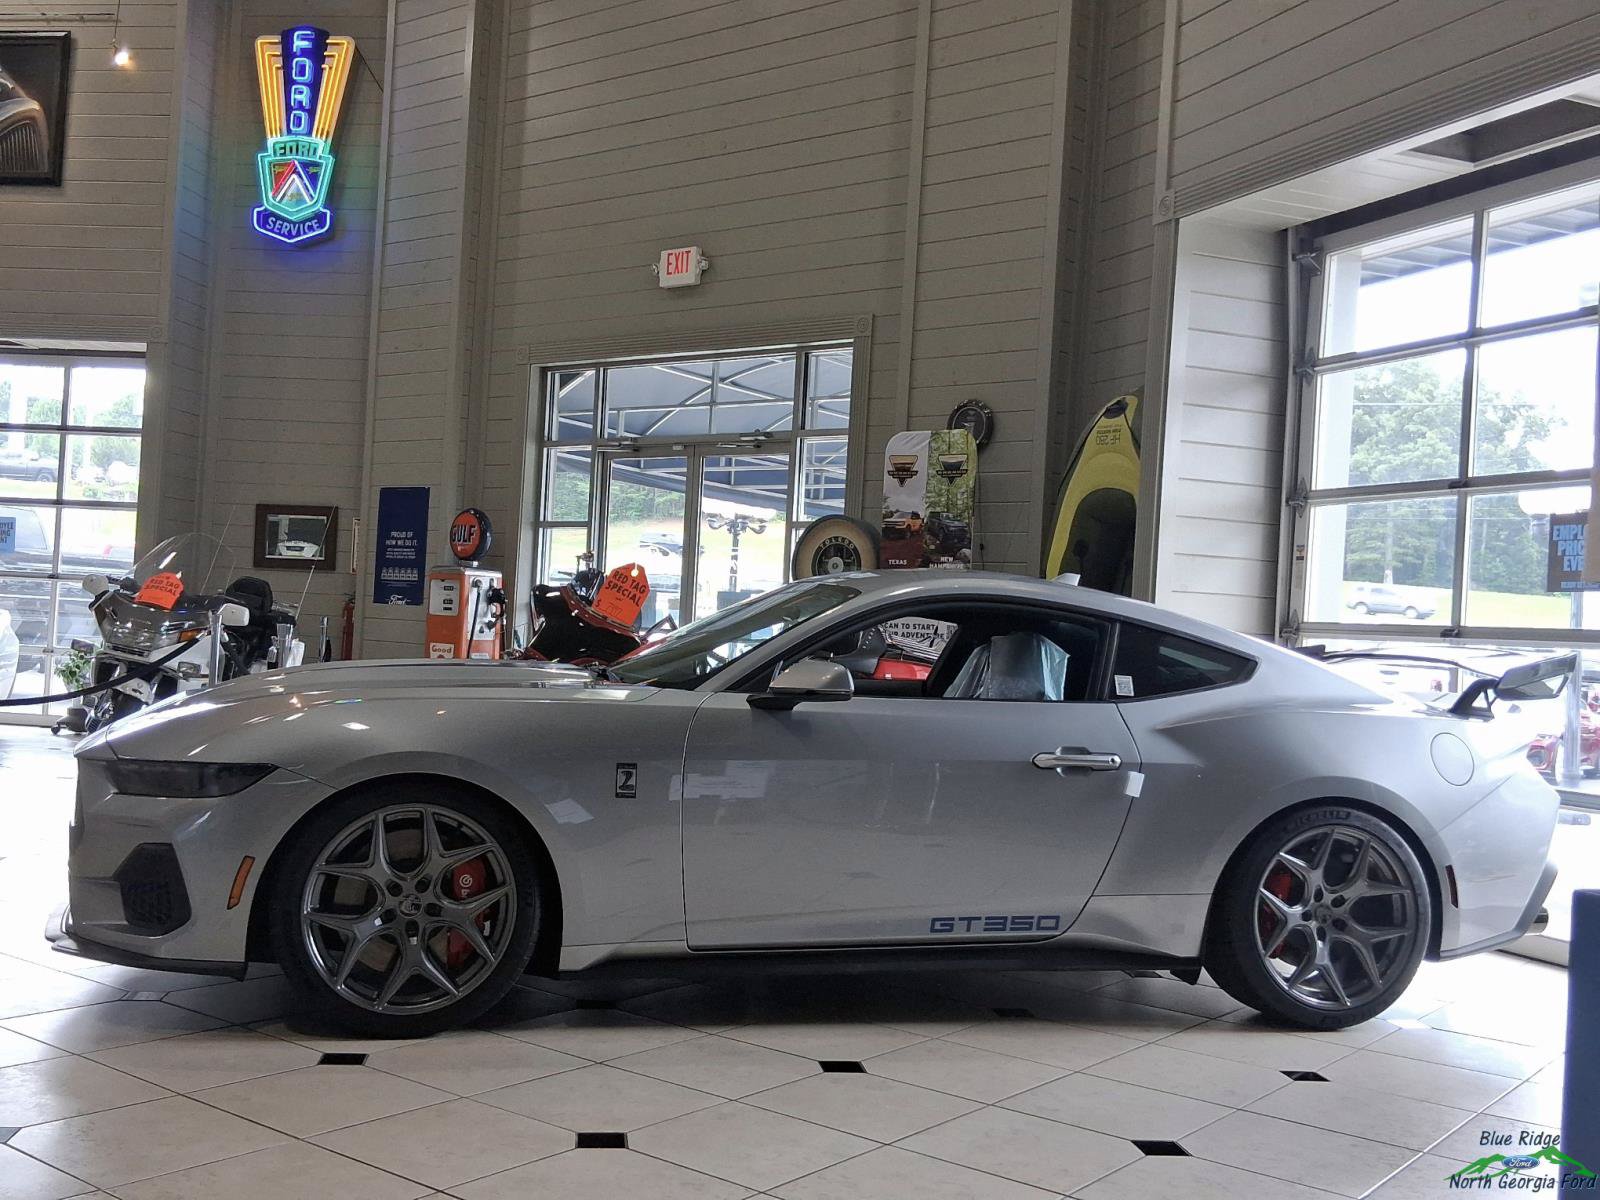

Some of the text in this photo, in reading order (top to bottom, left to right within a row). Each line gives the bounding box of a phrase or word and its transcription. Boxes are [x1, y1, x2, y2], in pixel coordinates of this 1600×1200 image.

[290, 31, 315, 133] FORD
[275, 142, 320, 158] FORD
[266, 217, 321, 236] SERVICE
[666, 250, 692, 275] EXIT
[451, 525, 476, 544] GULF
[820, 536, 855, 549] TOLEDO
[144, 584, 176, 596] SPECIAL
[612, 570, 647, 594] RED TAG
[605, 580, 641, 607] SPECIAL
[431, 645, 452, 654] Good
[930, 915, 1060, 933] GT350
